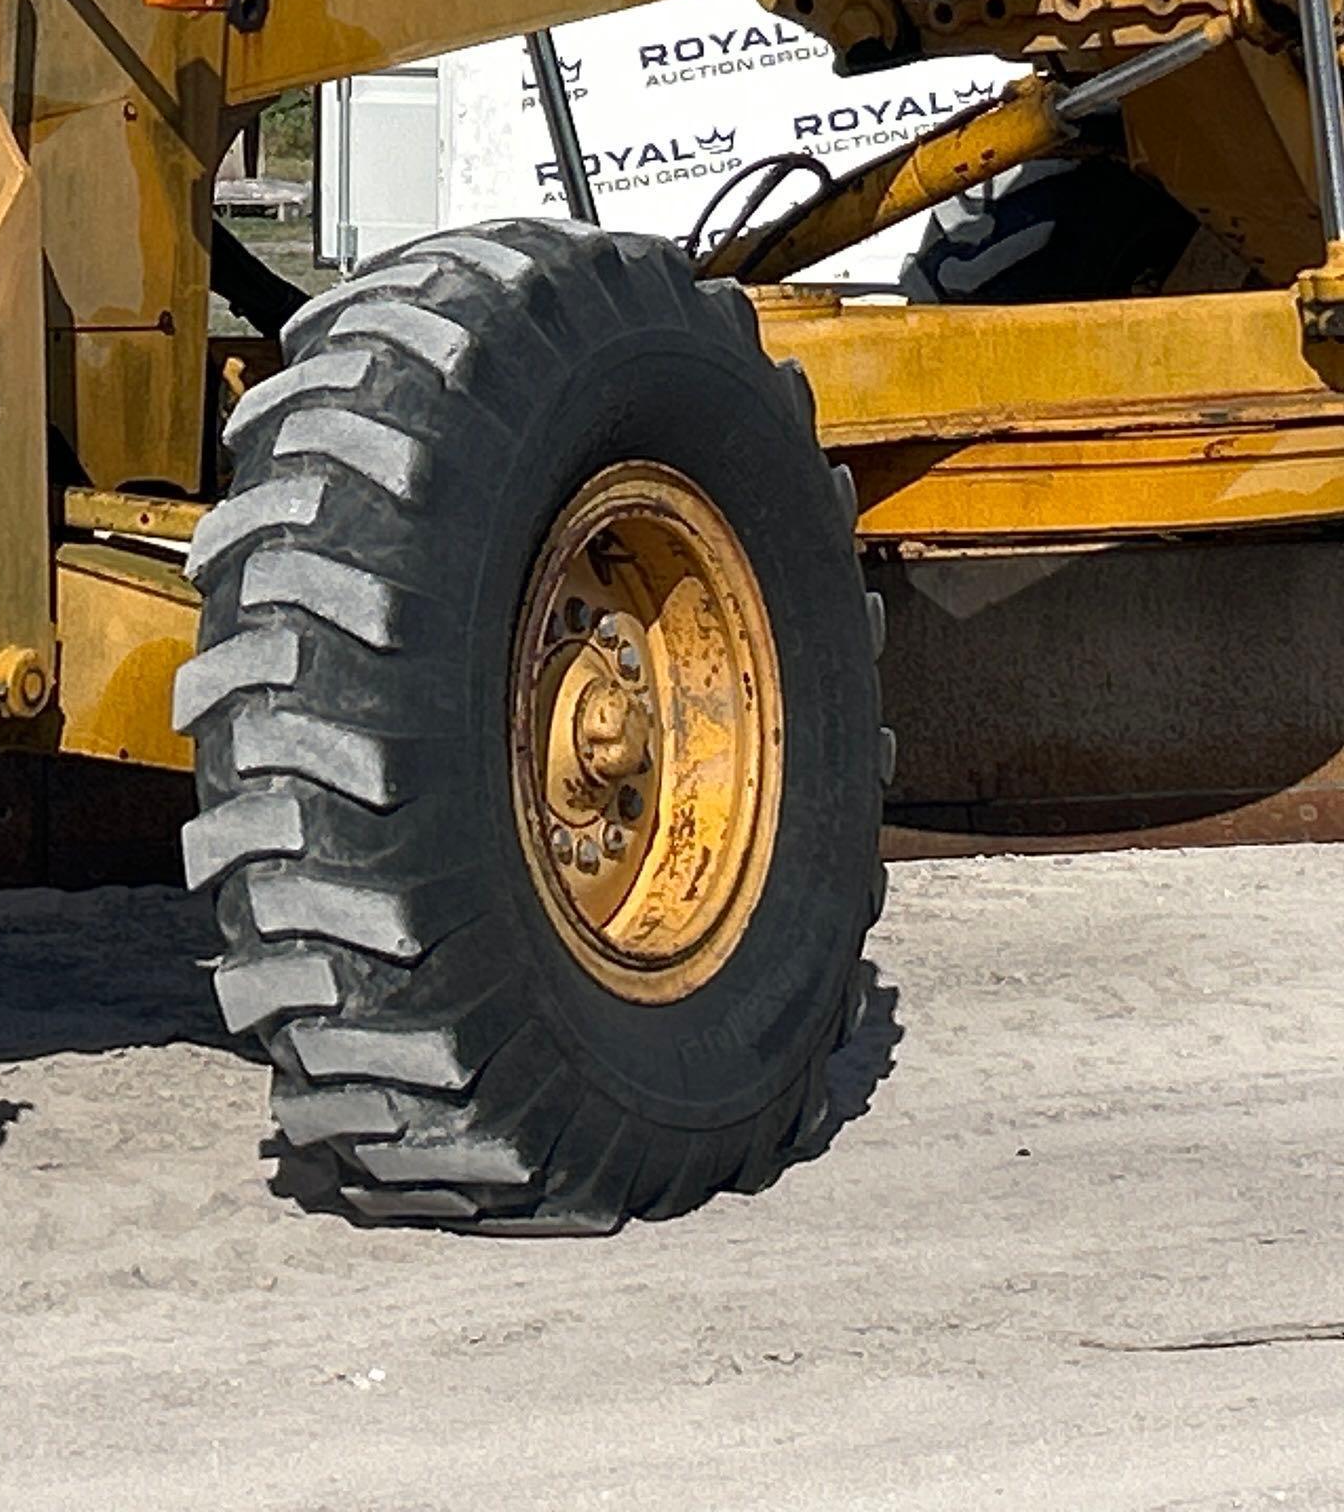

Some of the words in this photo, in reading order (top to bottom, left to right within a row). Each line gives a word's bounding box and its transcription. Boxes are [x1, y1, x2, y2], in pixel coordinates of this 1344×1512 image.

[639, 23, 799, 69] ROYAL
[646, 56, 755, 88] AUCTION
[759, 45, 830, 69] GROU
[794, 92, 953, 140] ROYAL
[656, 157, 742, 185] GROUP
